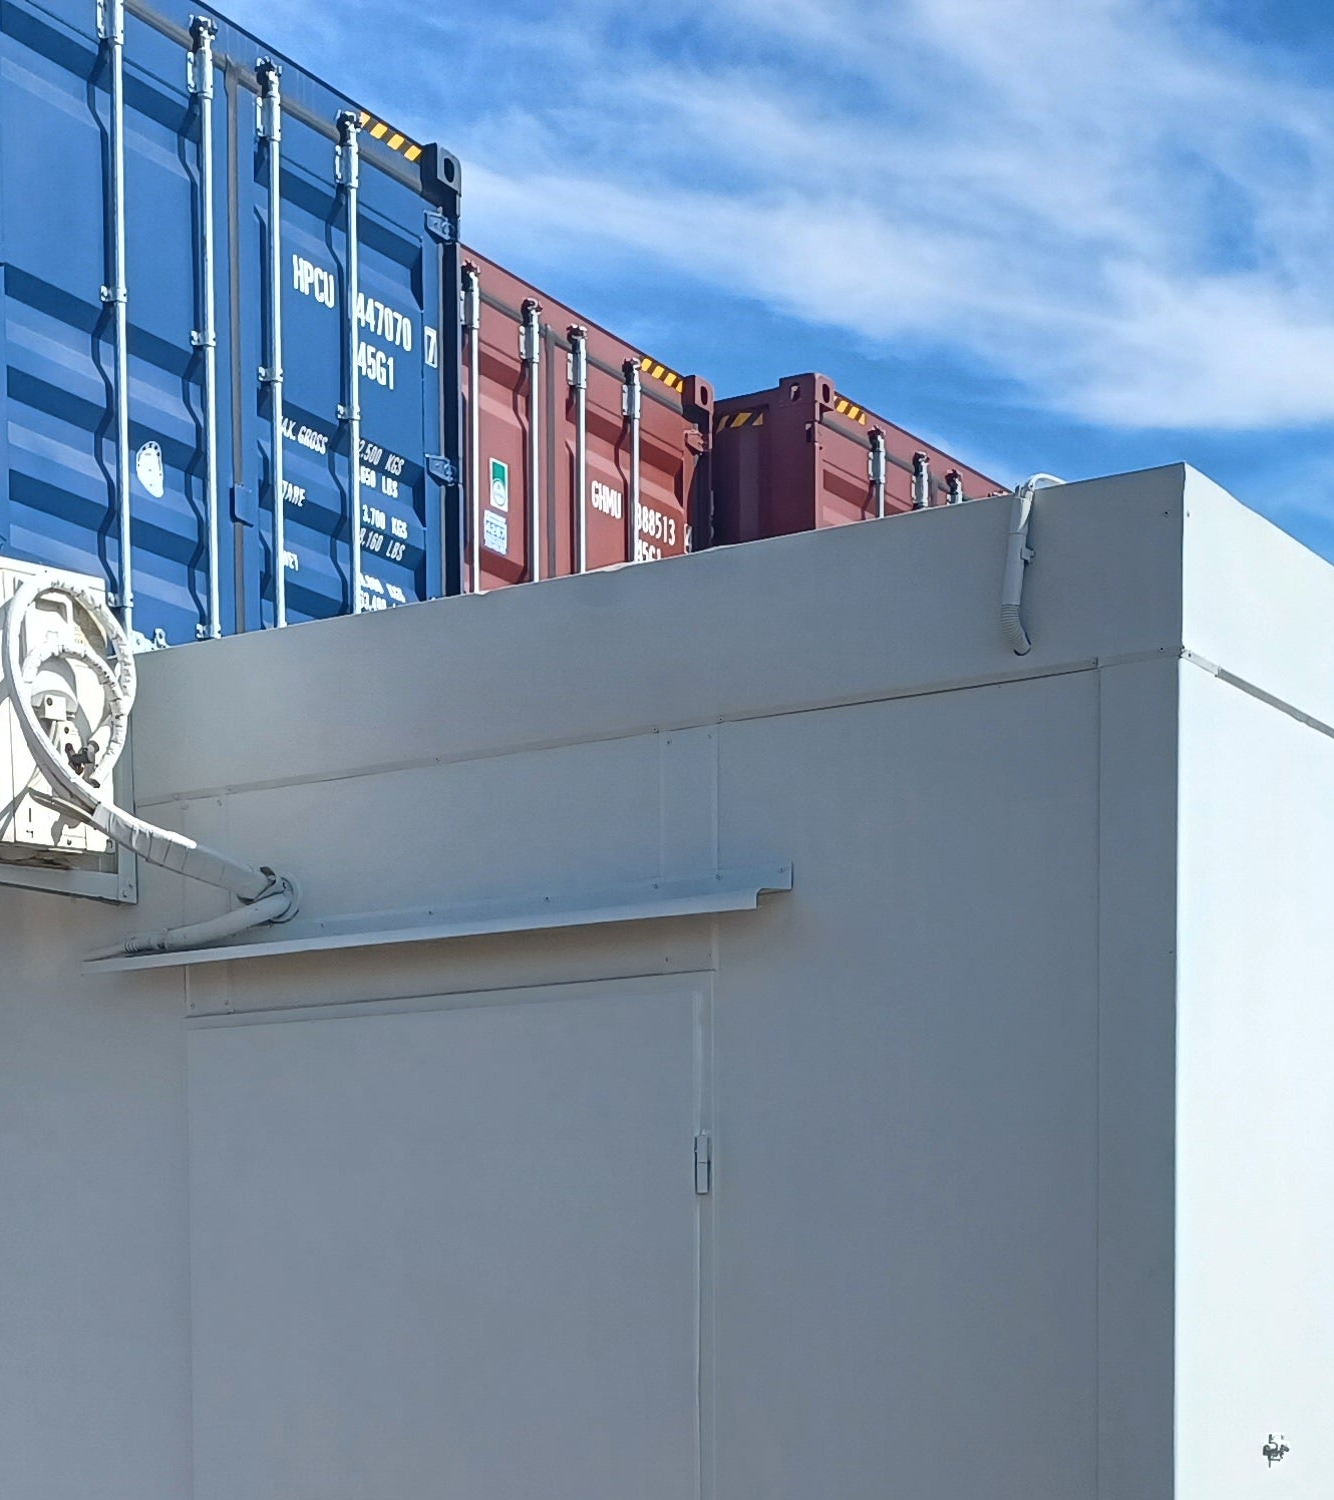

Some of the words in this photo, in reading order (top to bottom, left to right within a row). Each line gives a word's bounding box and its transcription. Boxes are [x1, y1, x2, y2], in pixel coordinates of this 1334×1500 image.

[292, 254, 335, 309] HPCU
[356, 292, 412, 352] 447070
[424, 326, 438, 369] 7
[357, 341, 394, 390] 45G1
[281, 416, 296, 441] AX.
[297, 425, 329, 455] GROSS
[384, 453, 405, 476] KGS
[282, 480, 306, 507] TARE
[381, 475, 398, 498] LBS
[591, 480, 622, 519] GHMU
[385, 540, 405, 561] LBS
